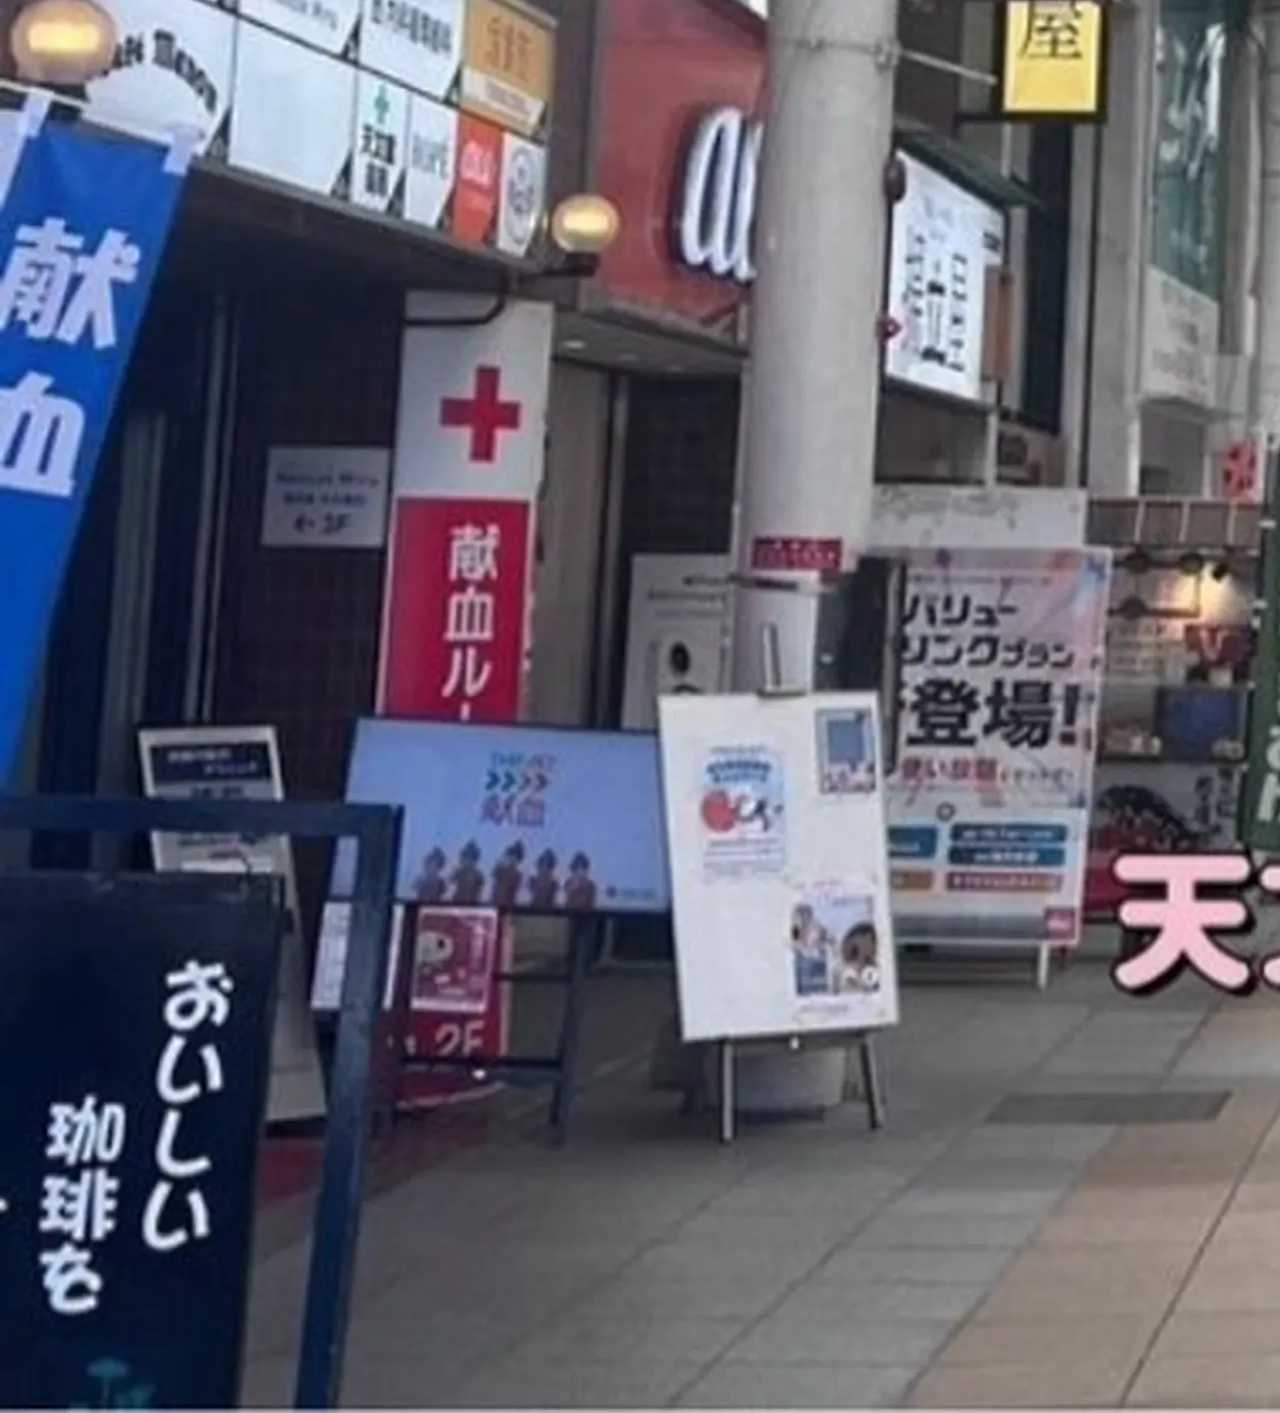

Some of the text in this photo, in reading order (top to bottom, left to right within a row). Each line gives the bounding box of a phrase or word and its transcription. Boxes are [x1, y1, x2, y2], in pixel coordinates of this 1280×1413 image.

[0, 215, 141, 499] 献血
[39, 1095, 126, 1314] 珈琲を
[142, 960, 232, 1250] おいしい
